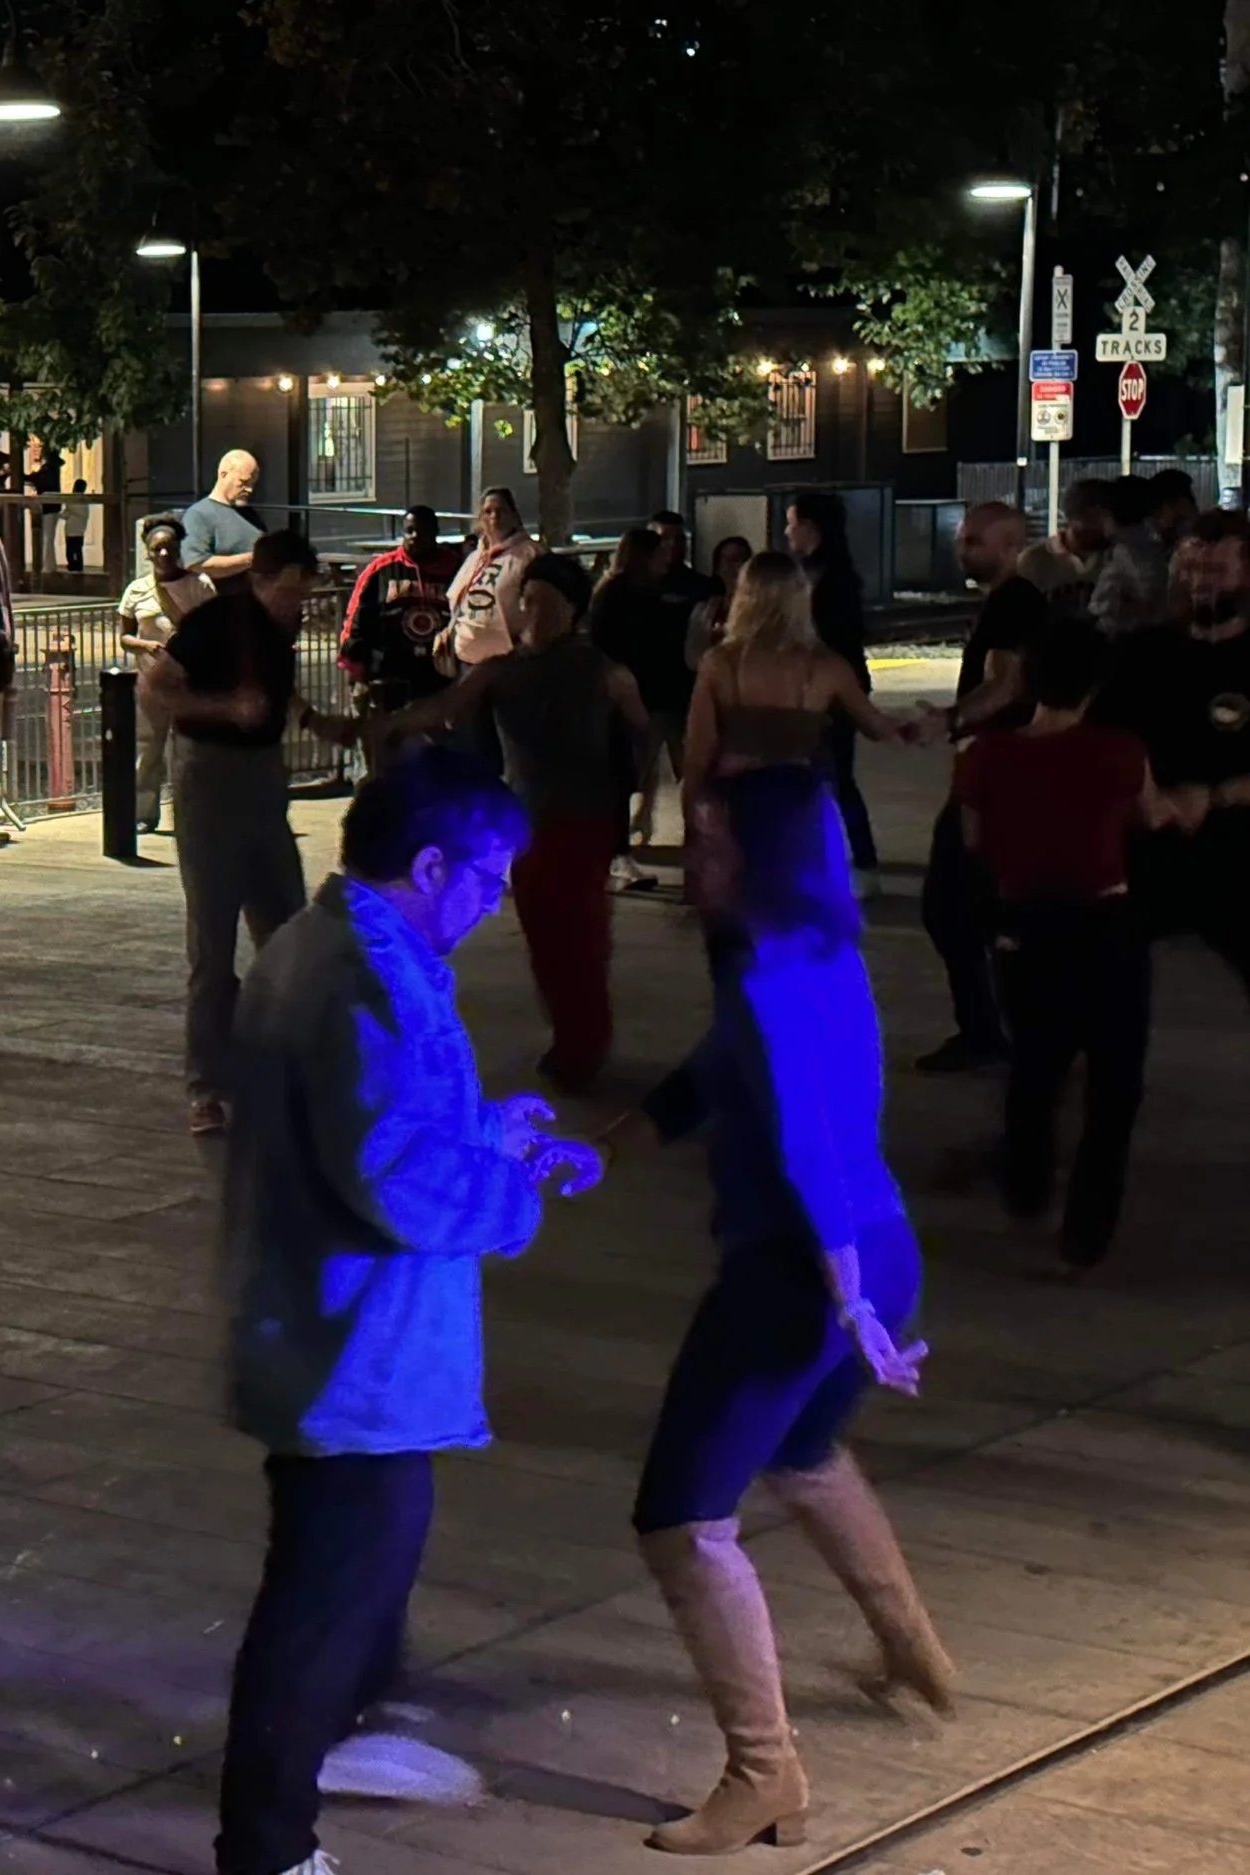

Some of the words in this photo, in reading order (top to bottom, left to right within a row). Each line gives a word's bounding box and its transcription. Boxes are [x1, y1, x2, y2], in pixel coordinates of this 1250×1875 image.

[1129, 312, 1139, 331] 2
[1100, 339, 1163, 355] TRACKS
[1121, 377, 1145, 402] STOP
